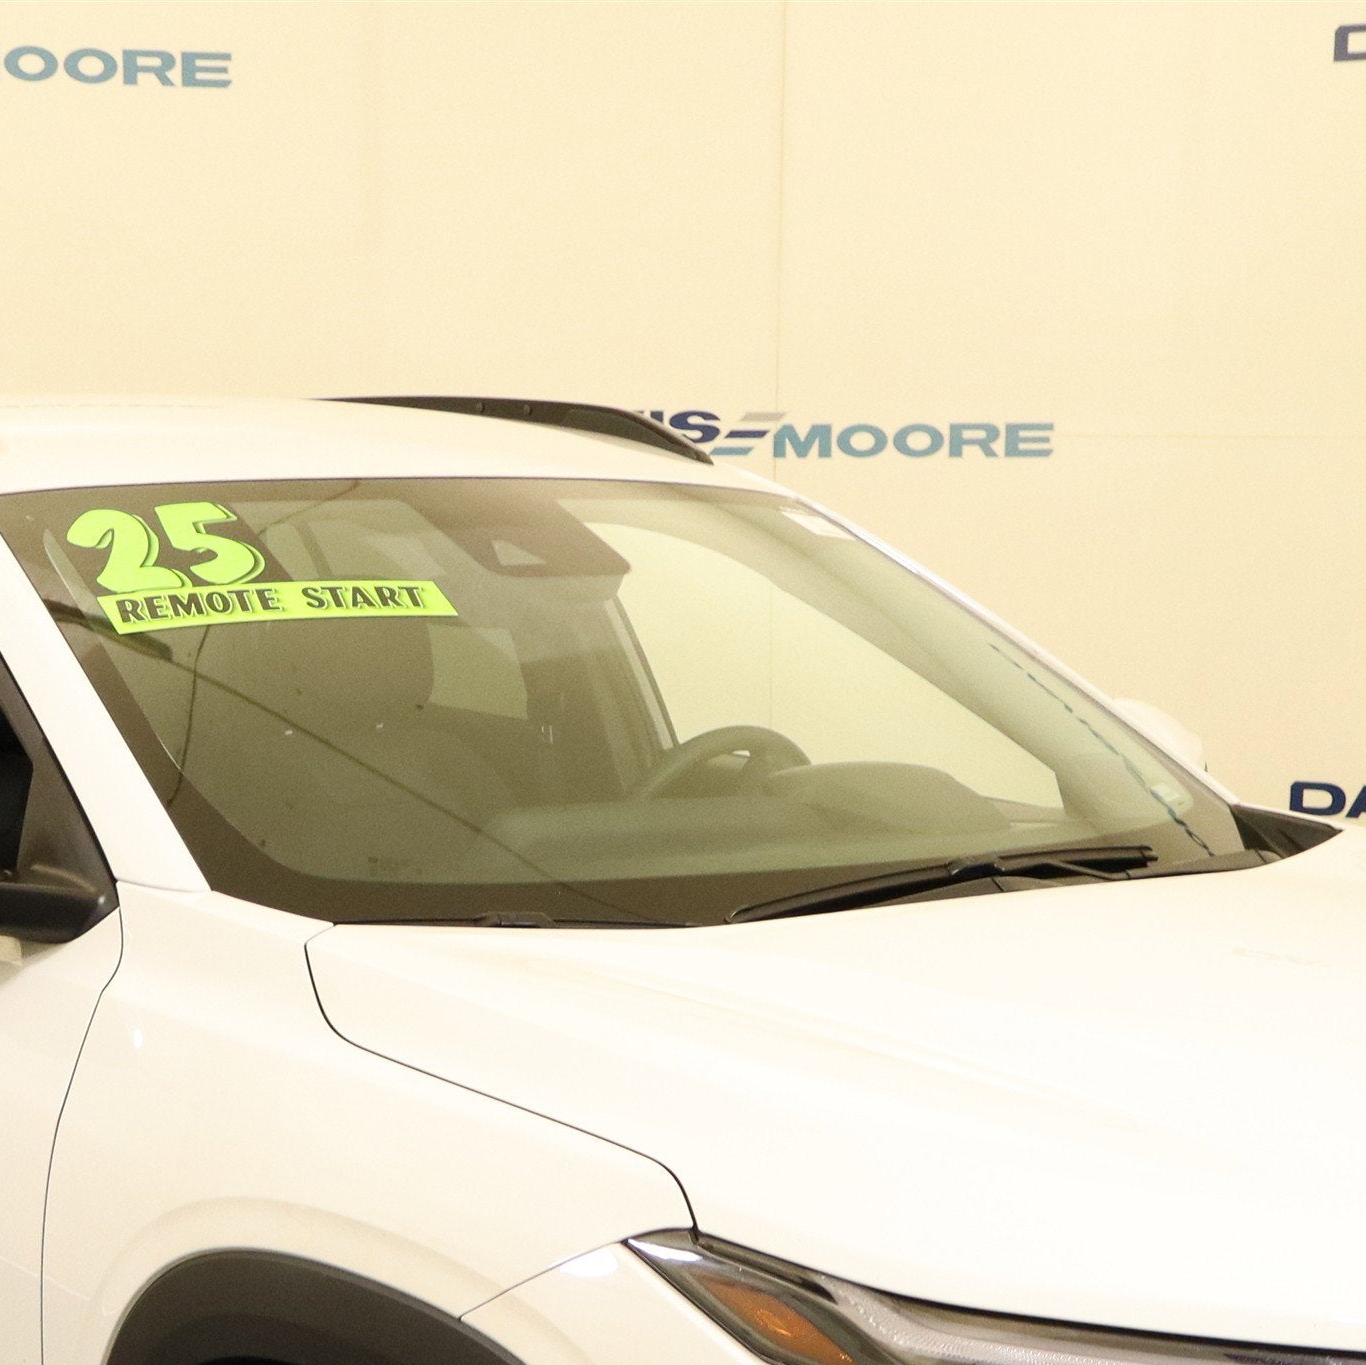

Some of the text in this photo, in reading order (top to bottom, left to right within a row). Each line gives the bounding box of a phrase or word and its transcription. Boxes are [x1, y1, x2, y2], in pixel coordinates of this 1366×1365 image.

[772, 422, 1055, 459] MOORE
[67, 501, 266, 598] 25
[116, 585, 426, 624] REMOTE START
